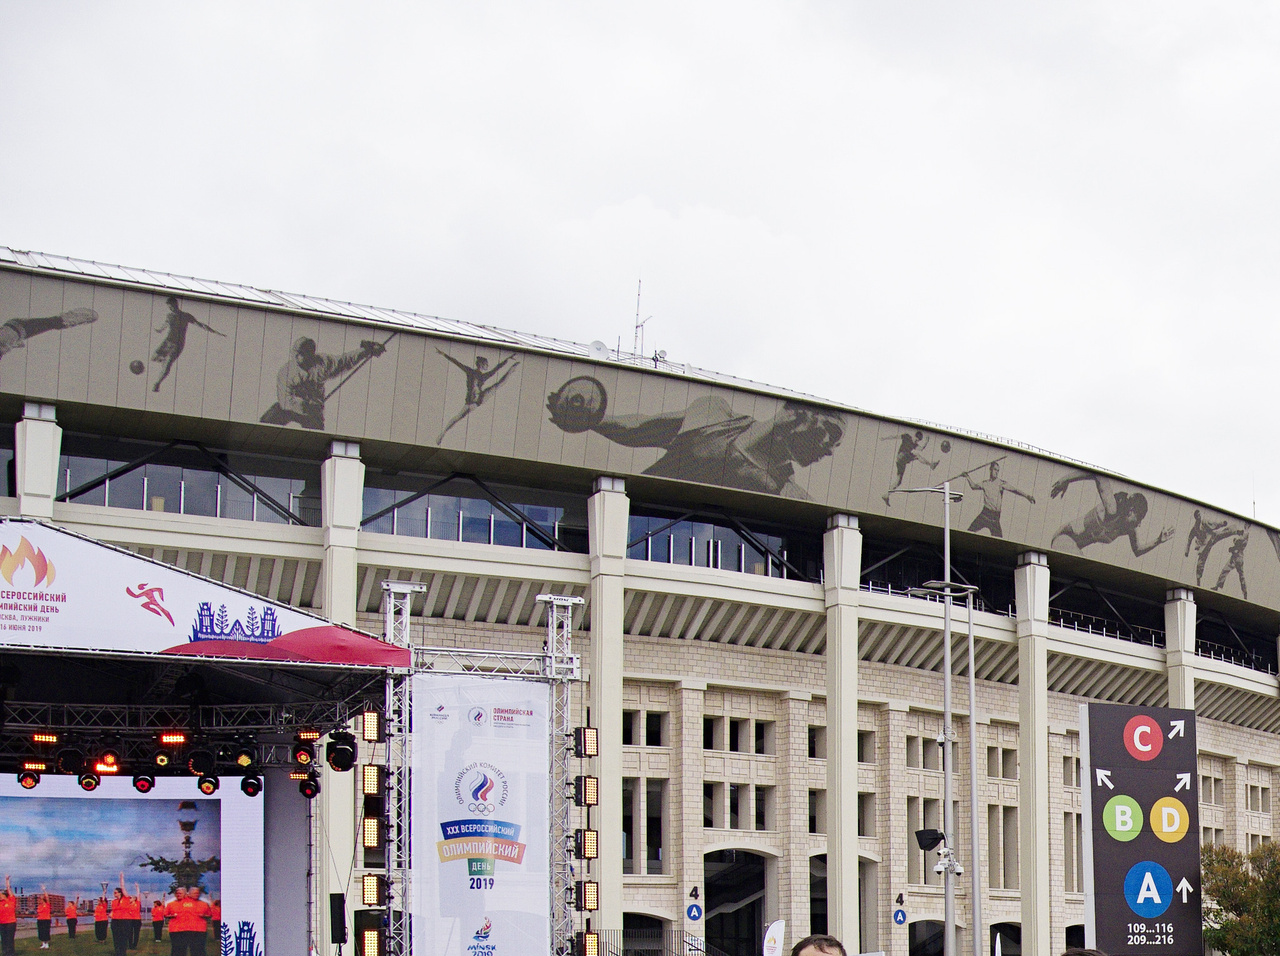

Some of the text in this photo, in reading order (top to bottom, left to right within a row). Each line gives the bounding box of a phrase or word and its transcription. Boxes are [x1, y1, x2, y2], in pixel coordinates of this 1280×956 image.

[0, 590, 67, 603] СЕРОССИЙСКИЙ
[40, 604, 60, 614] ДЕНЬ
[493, 707, 534, 716] ОЛИМПИЙСКАЯ
[1133, 725, 1152, 752] C
[1115, 805, 1133, 831] B
[1161, 807, 1180, 833] D
[460, 824, 515, 836] ВСЕРОССИЙСКИЙ
[442, 840, 519, 858] ОЛИМПИЙСКИЙ
[471, 862, 491, 872] ДЕНЬ
[469, 877, 494, 890] 2019
[1136, 871, 1162, 904] A
[689, 886, 699, 900] 4
[895, 893, 904, 905] 4
[690, 907, 698, 917] A
[1127, 923, 1174, 933] 109...116
[1127, 934, 1174, 945] 209...216
